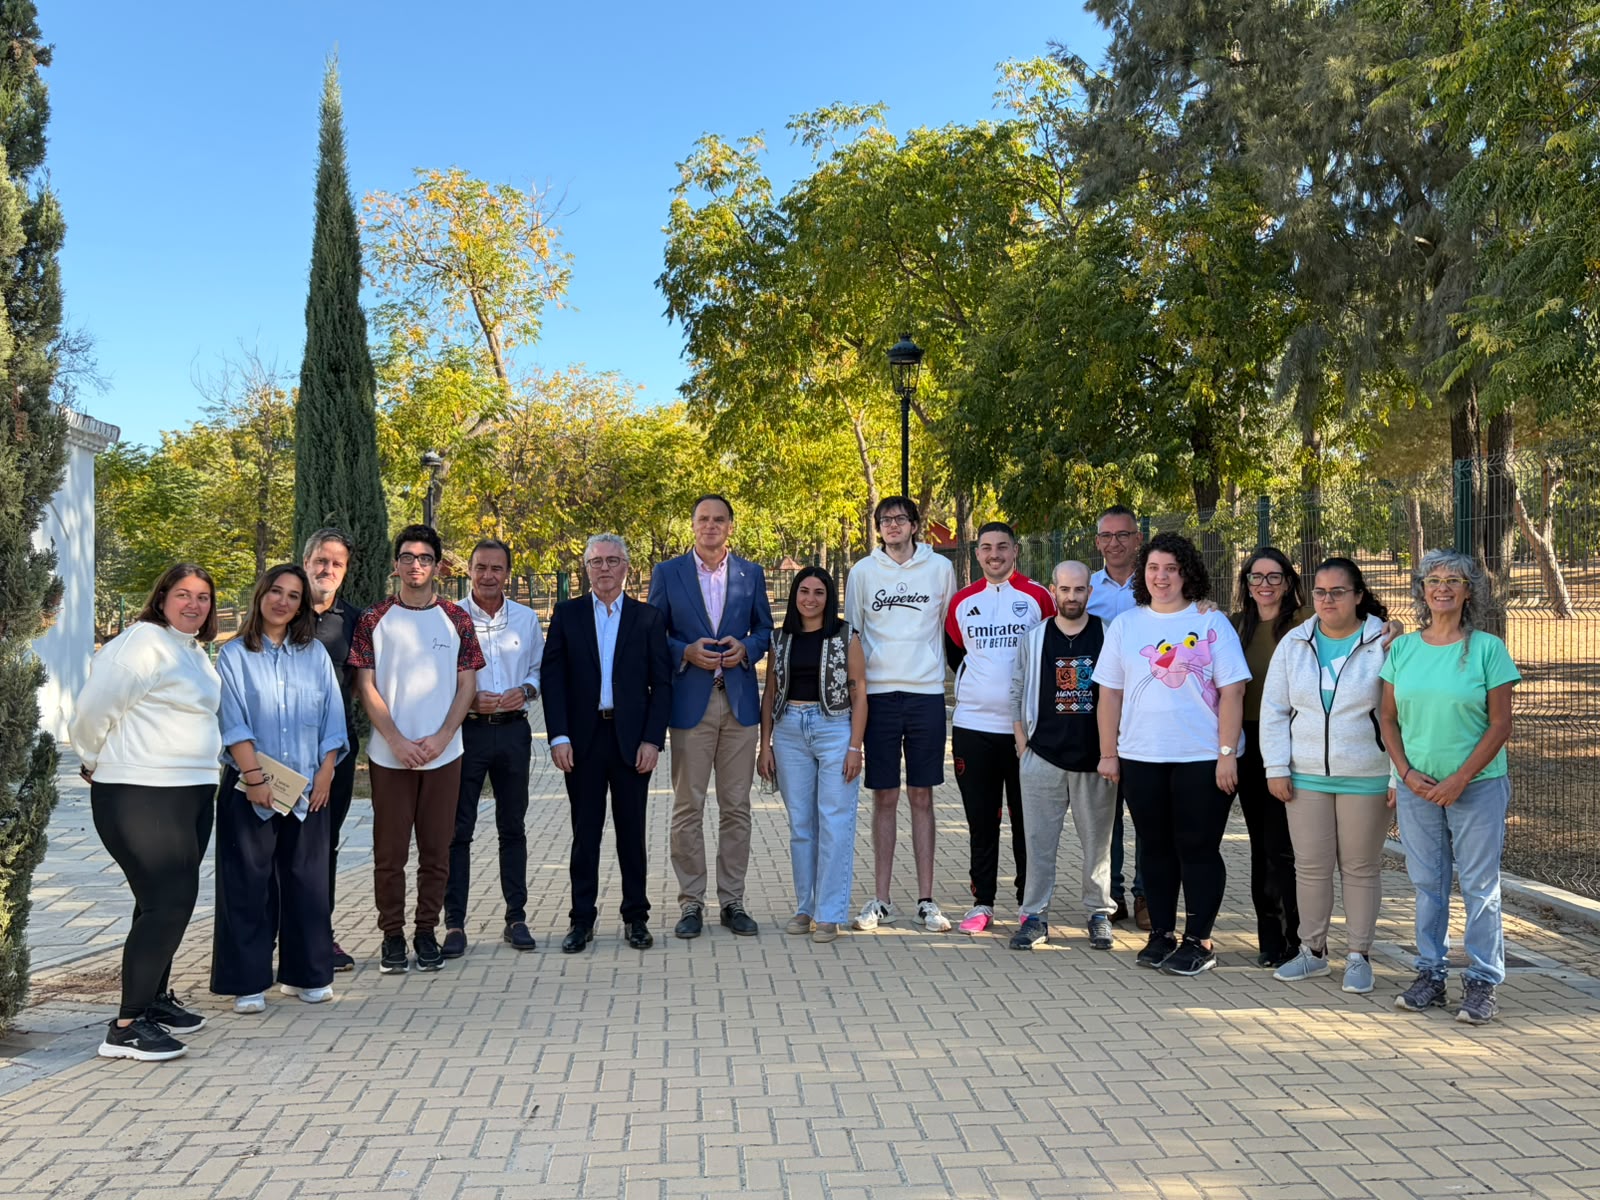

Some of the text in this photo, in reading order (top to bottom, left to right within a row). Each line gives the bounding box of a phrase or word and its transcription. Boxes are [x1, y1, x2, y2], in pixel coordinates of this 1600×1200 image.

[871, 588, 930, 612] Superior
[966, 623, 1027, 639] Emirates
[989, 636, 1018, 649] BETTER
[1055, 690, 1094, 698] MENDOZA
